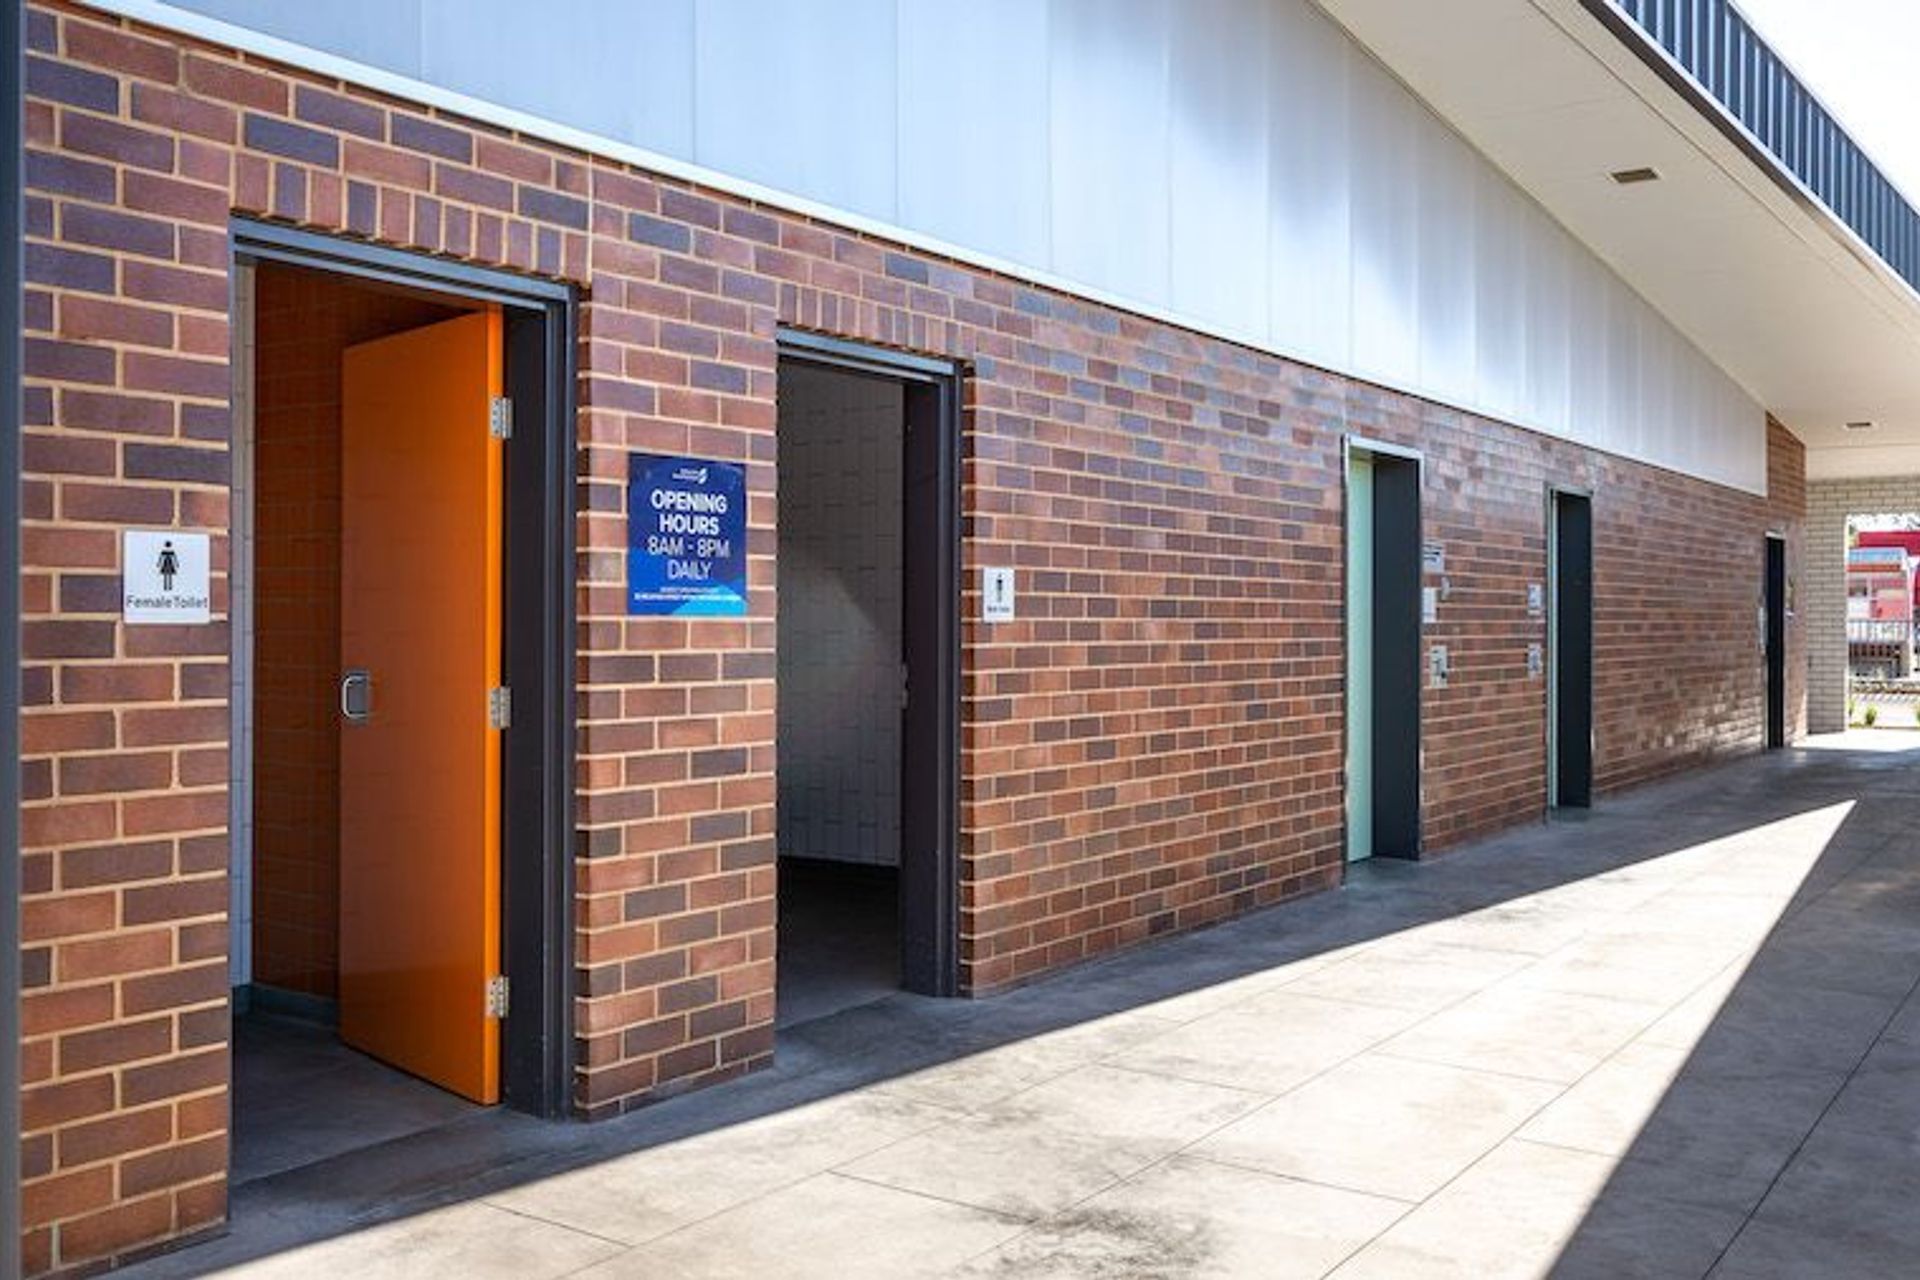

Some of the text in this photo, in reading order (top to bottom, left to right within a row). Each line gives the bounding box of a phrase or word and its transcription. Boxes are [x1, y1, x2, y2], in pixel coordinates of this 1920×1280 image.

[651, 489, 727, 514] OPENING
[660, 513, 719, 535] HOURS
[647, 535, 684, 556] 8AM
[697, 538, 730, 558] 8PM
[666, 559, 712, 580] DAILY
[126, 595, 208, 608] Female Toilet
